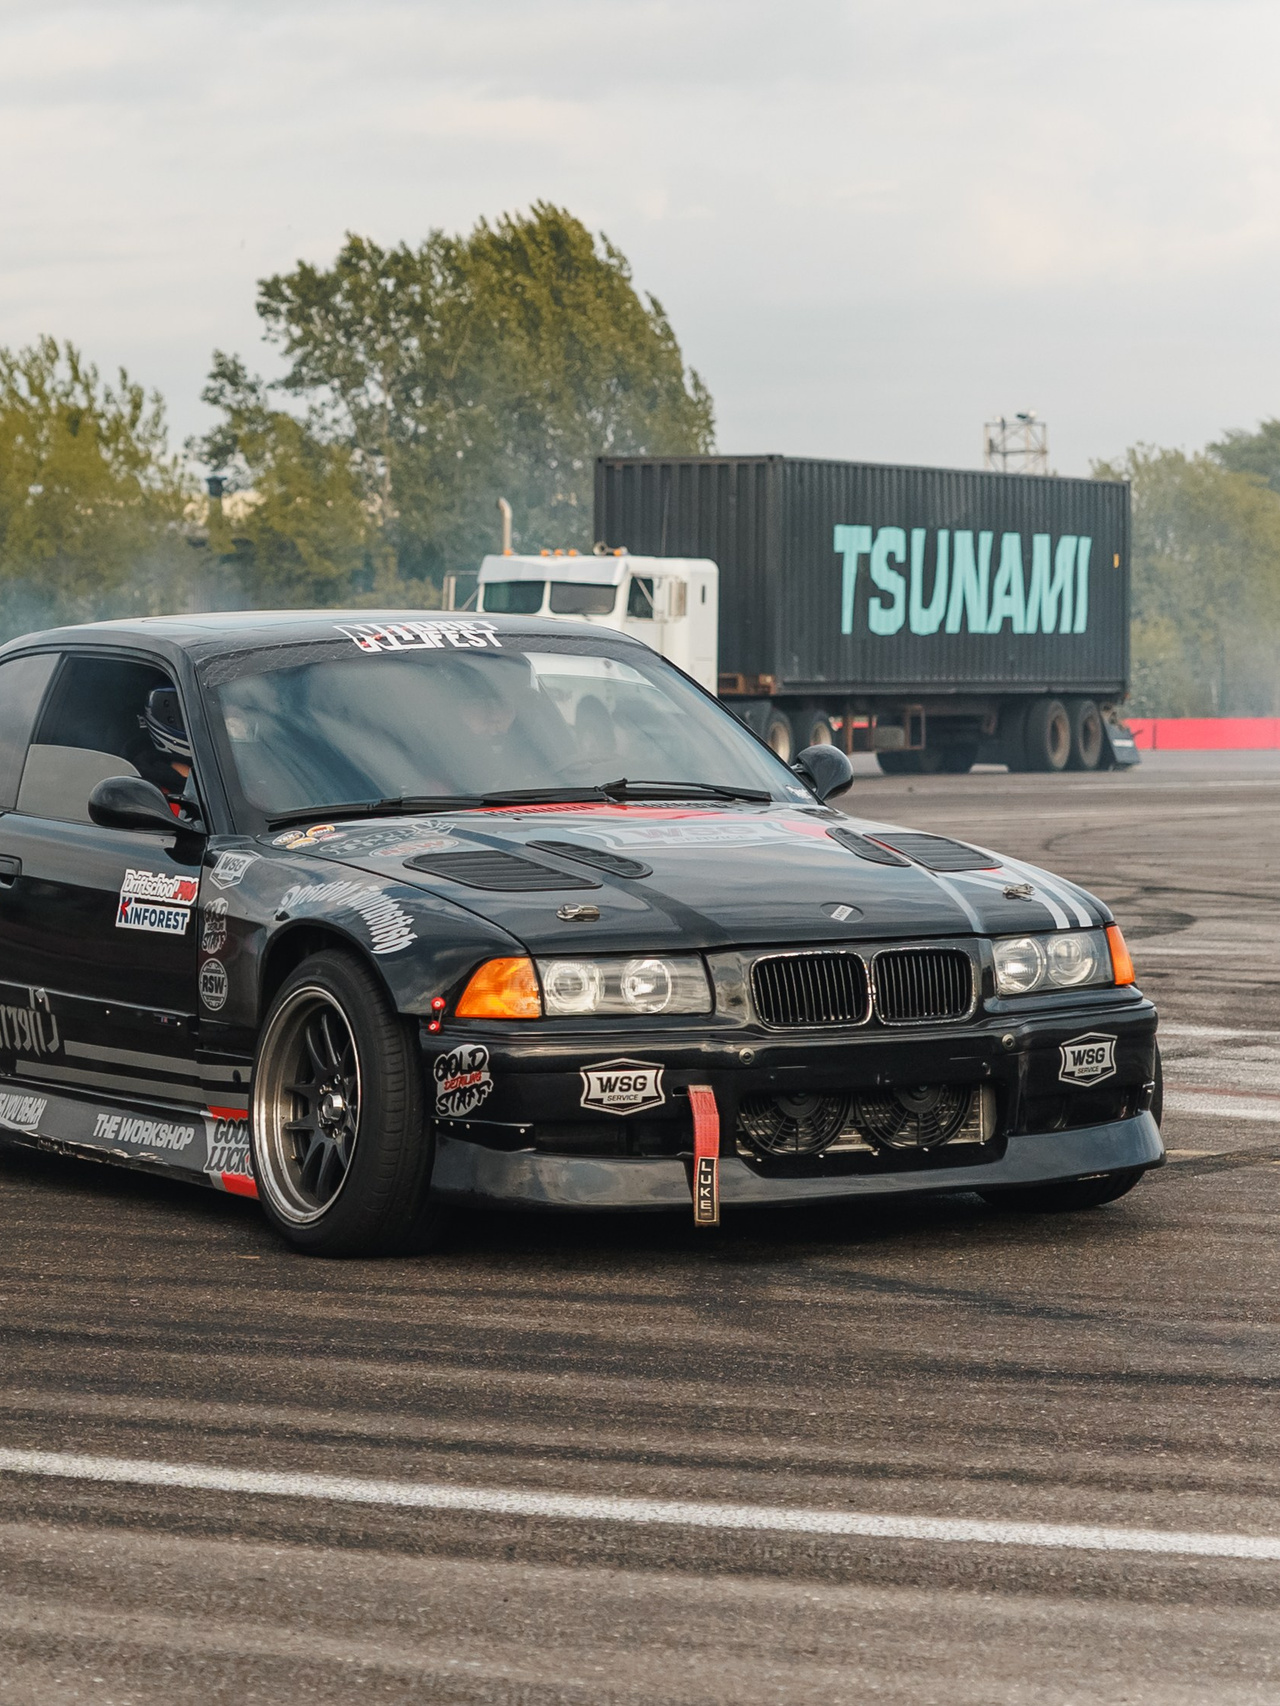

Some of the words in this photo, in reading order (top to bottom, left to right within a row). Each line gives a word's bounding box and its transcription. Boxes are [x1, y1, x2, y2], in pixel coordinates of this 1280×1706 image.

[833, 524, 1092, 636] TSUNAMI
[410, 620, 499, 631] DRIFT
[422, 630, 503, 648] FEST
[628, 826, 760, 840] WSG
[221, 856, 247, 872] WSG
[118, 896, 189, 931] KINFOREST
[202, 974, 225, 995] RSW
[435, 1047, 488, 1082] GOLD
[1070, 1047, 1106, 1067] WSG
[1077, 1065, 1100, 1075] SERVICE
[596, 1075, 648, 1094] WSG
[437, 1080, 493, 1115] STAFF
[606, 1093, 639, 1102] SERVICE
[92, 1113, 122, 1139] THE
[117, 1117, 195, 1151] WORKSHOP
[700, 1160, 713, 1211] LUKE
